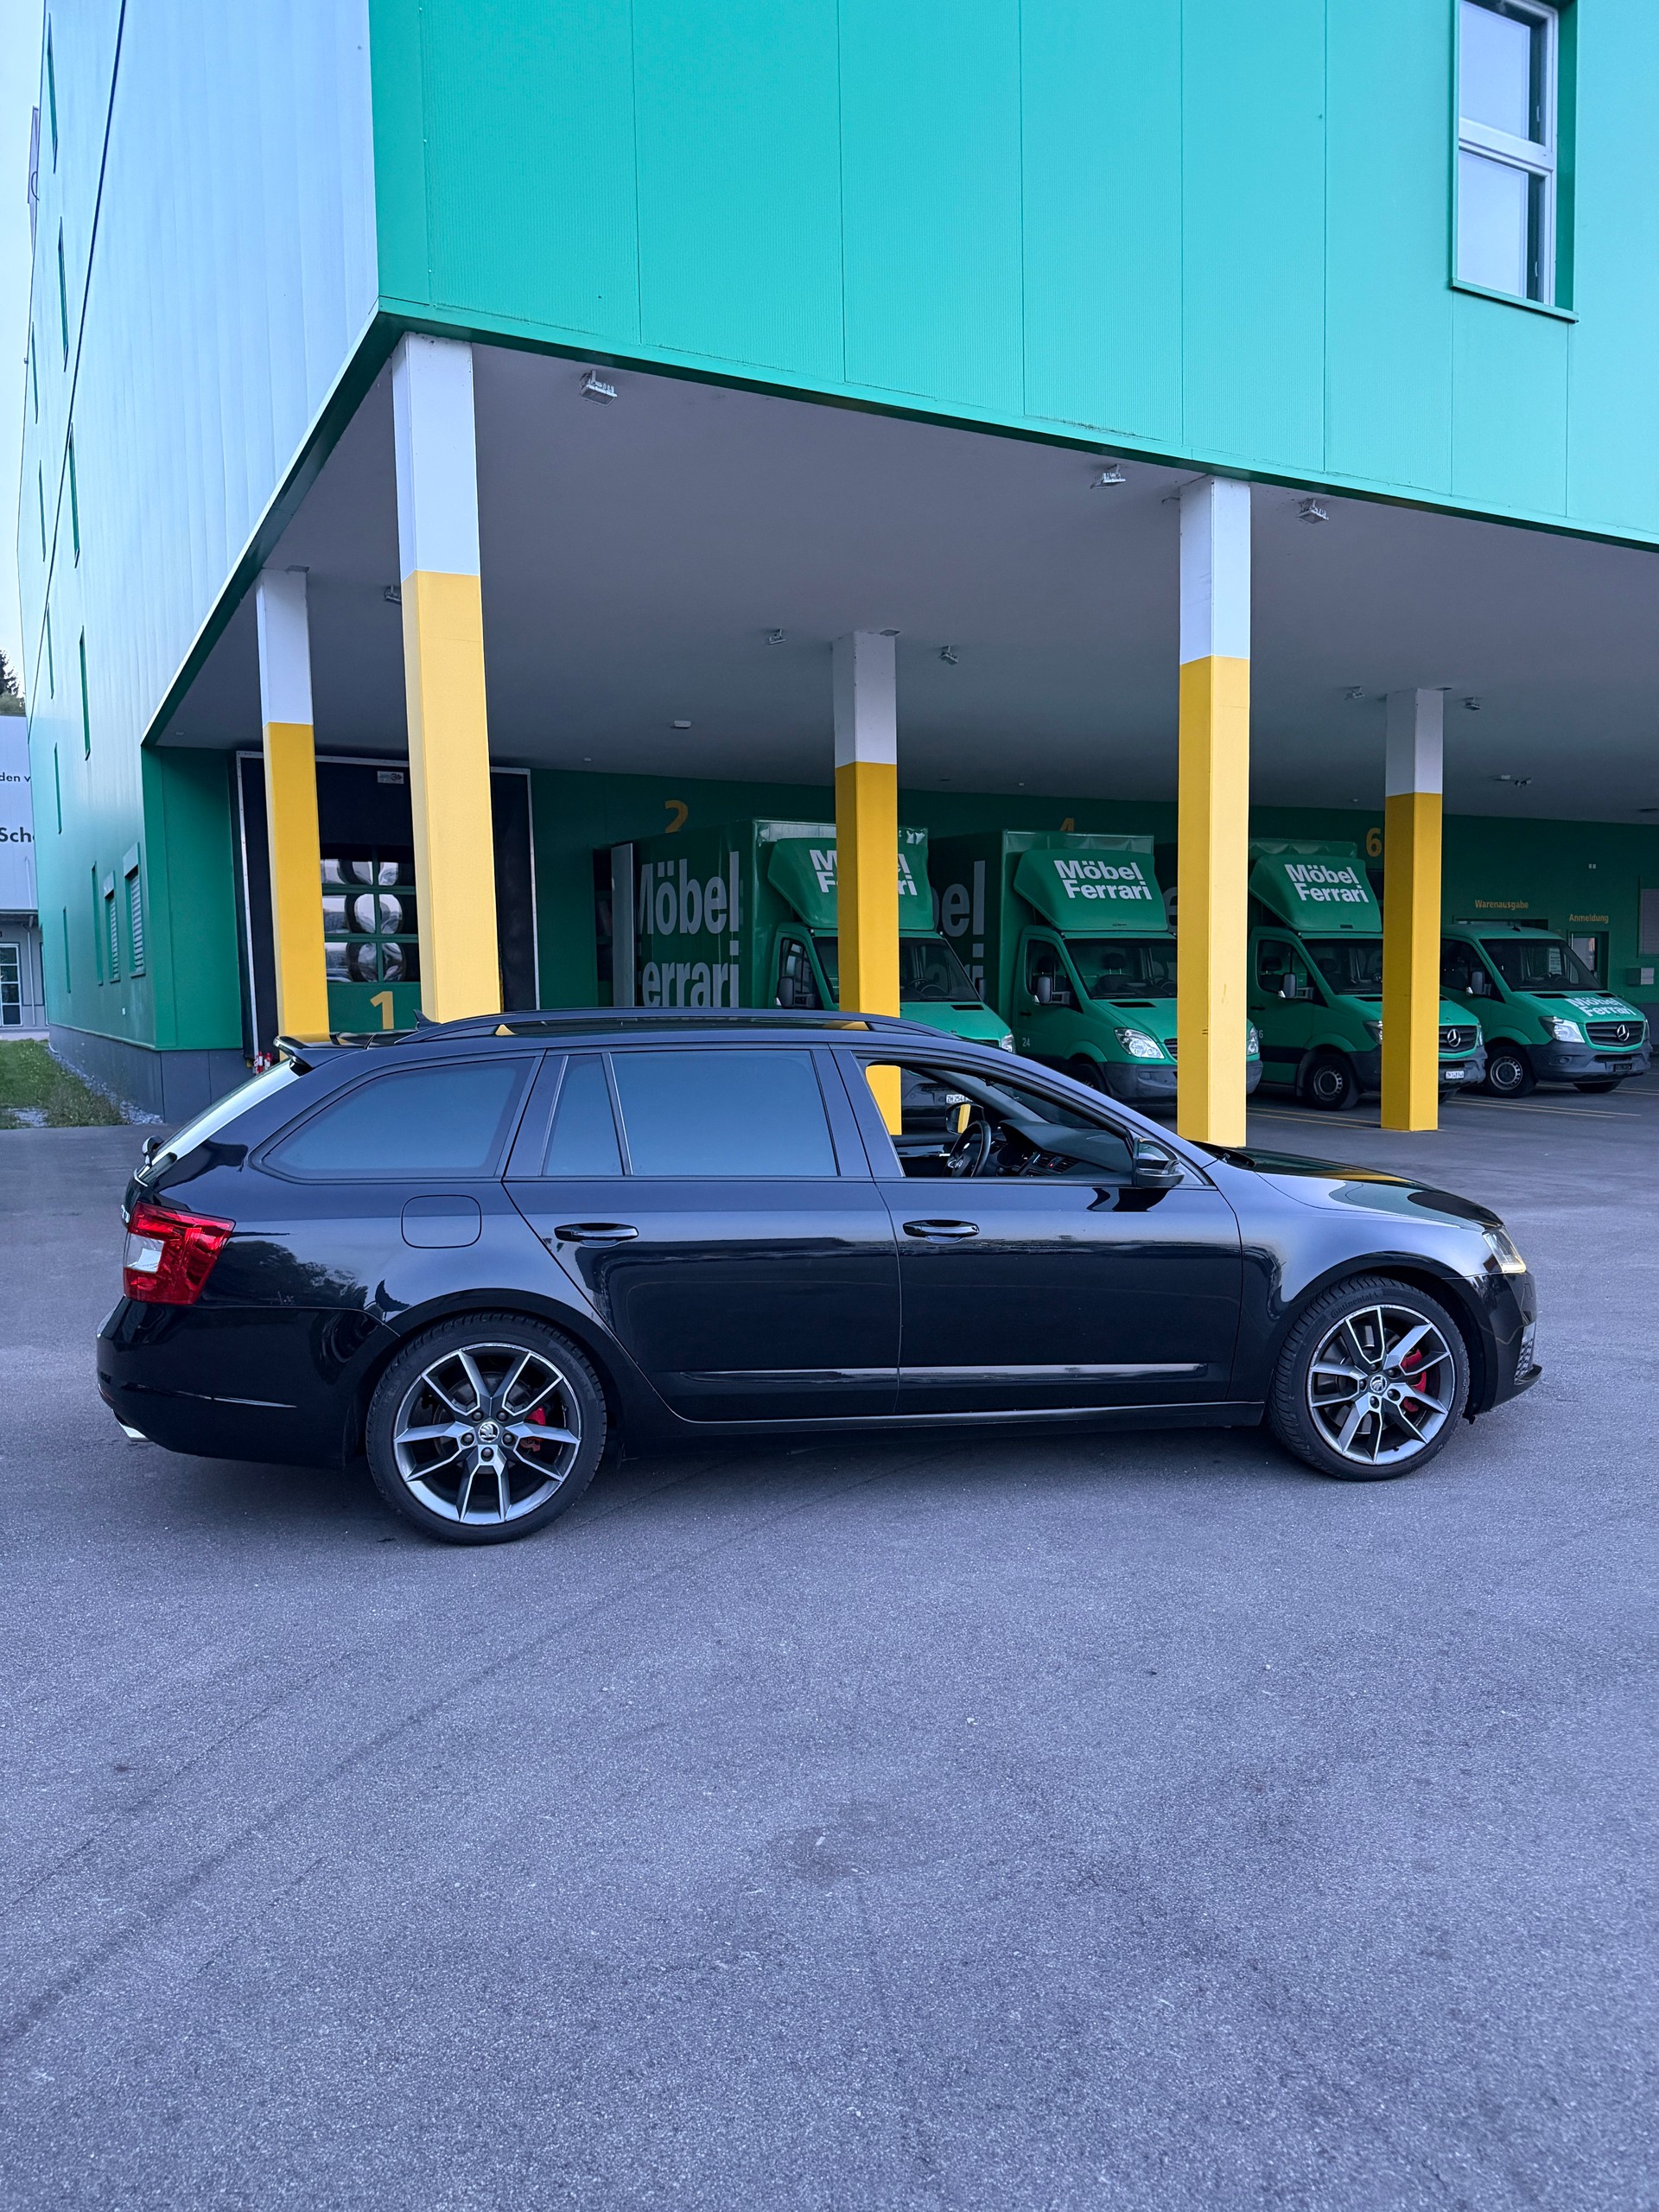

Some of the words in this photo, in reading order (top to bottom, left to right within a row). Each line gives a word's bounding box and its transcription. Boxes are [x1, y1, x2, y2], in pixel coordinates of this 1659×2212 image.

[664, 800, 689, 833] 2
[0, 827, 35, 842] Sch
[1366, 827, 1382, 858] 6
[1053, 860, 1144, 880] Möbel
[1284, 864, 1359, 884] Möbel
[1062, 880, 1153, 900] Ferrari
[1294, 882, 1369, 903] Ferrari
[1474, 899, 1529, 910] Warenausgabe
[1569, 913, 1609, 924] Anmeldung
[638, 940, 740, 1007] errari
[370, 991, 395, 1030] 1
[1565, 997, 1627, 1008] Möbel
[1579, 1006, 1637, 1017] Ferrari
[1022, 1037, 1031, 1047] 24
